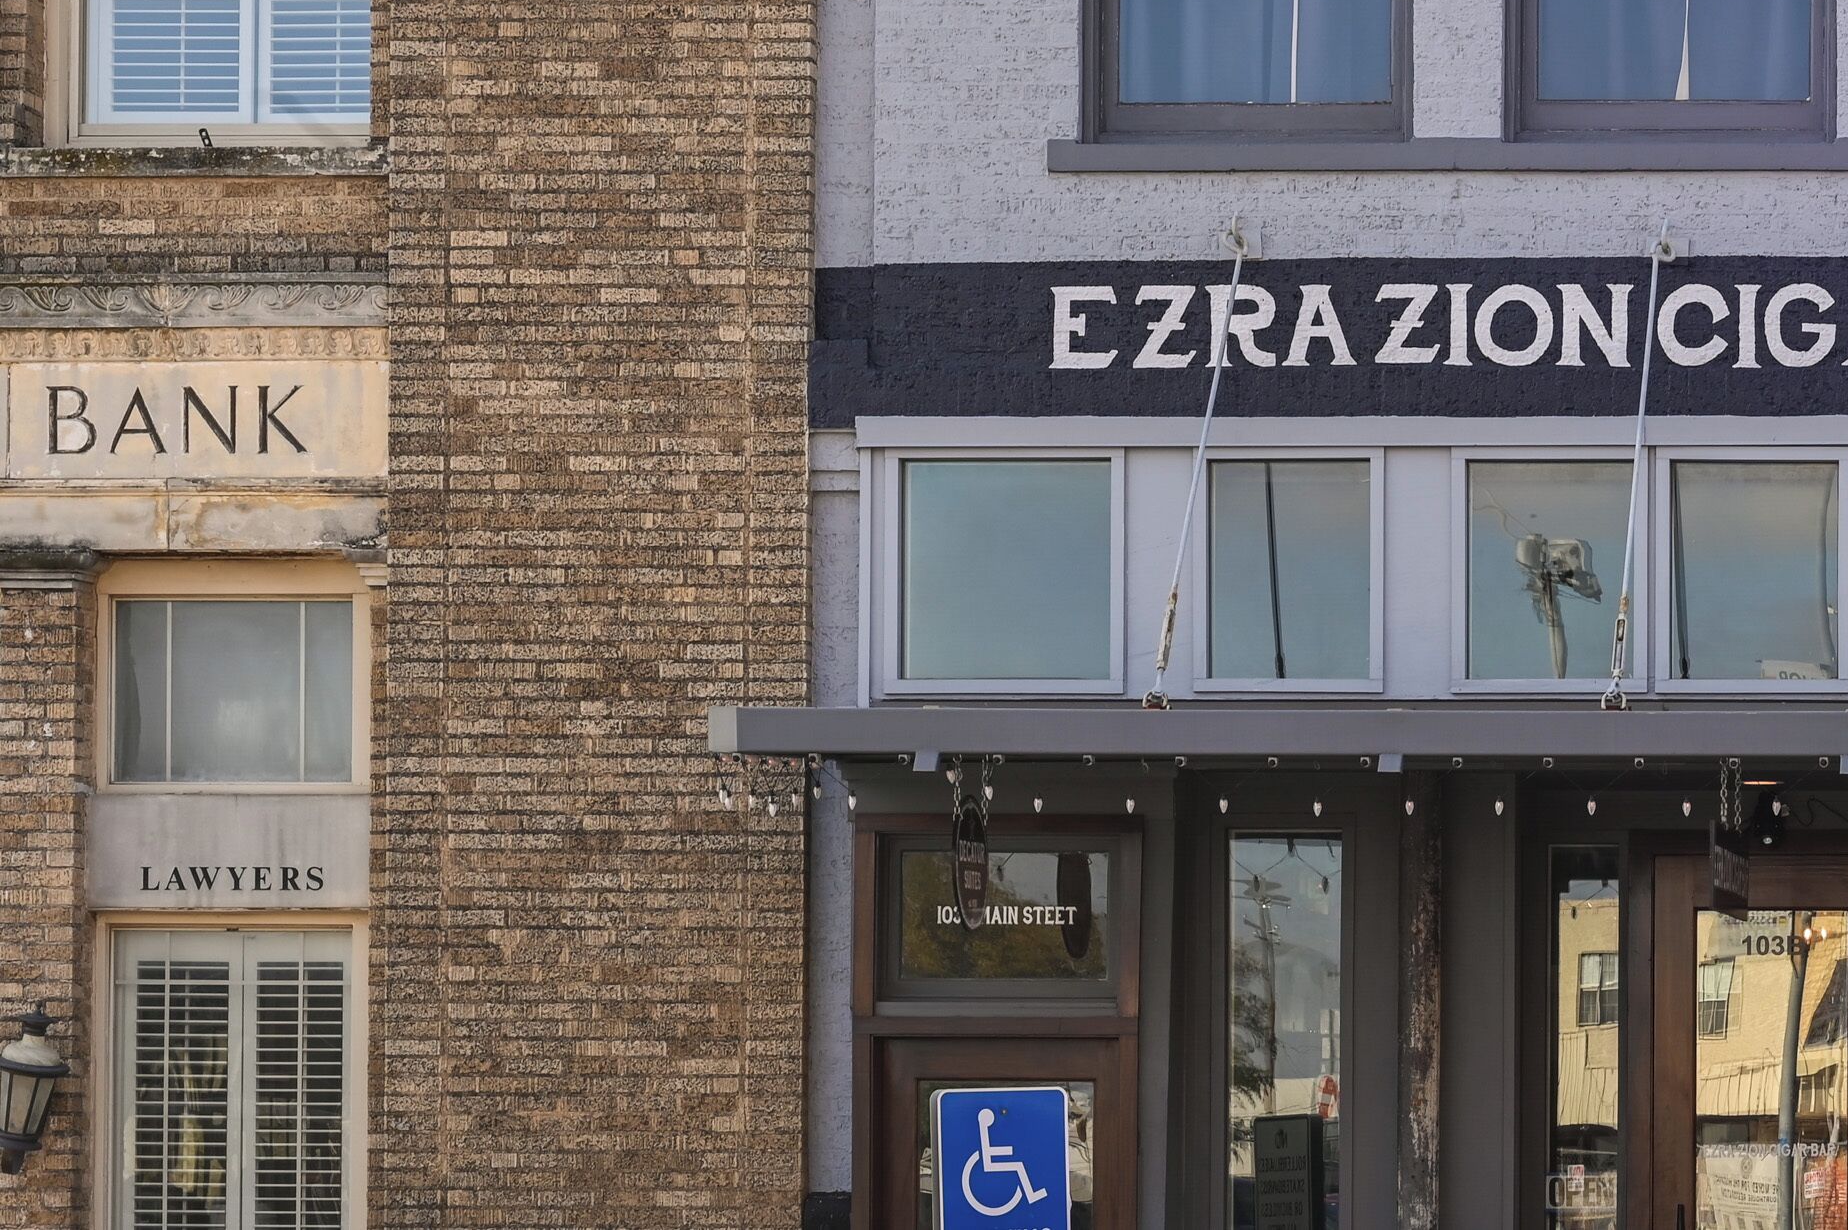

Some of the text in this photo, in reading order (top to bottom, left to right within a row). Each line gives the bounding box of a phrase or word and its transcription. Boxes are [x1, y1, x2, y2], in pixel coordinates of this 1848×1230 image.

[1049, 284, 1354, 369] EZRA
[1374, 283, 1635, 368] ZION
[45, 385, 308, 455] BANK
[958, 839, 986, 865] DECATUR
[140, 865, 326, 892] LAWYERS
[1022, 905, 1078, 925] STEET
[1741, 935, 1803, 956] 103B
